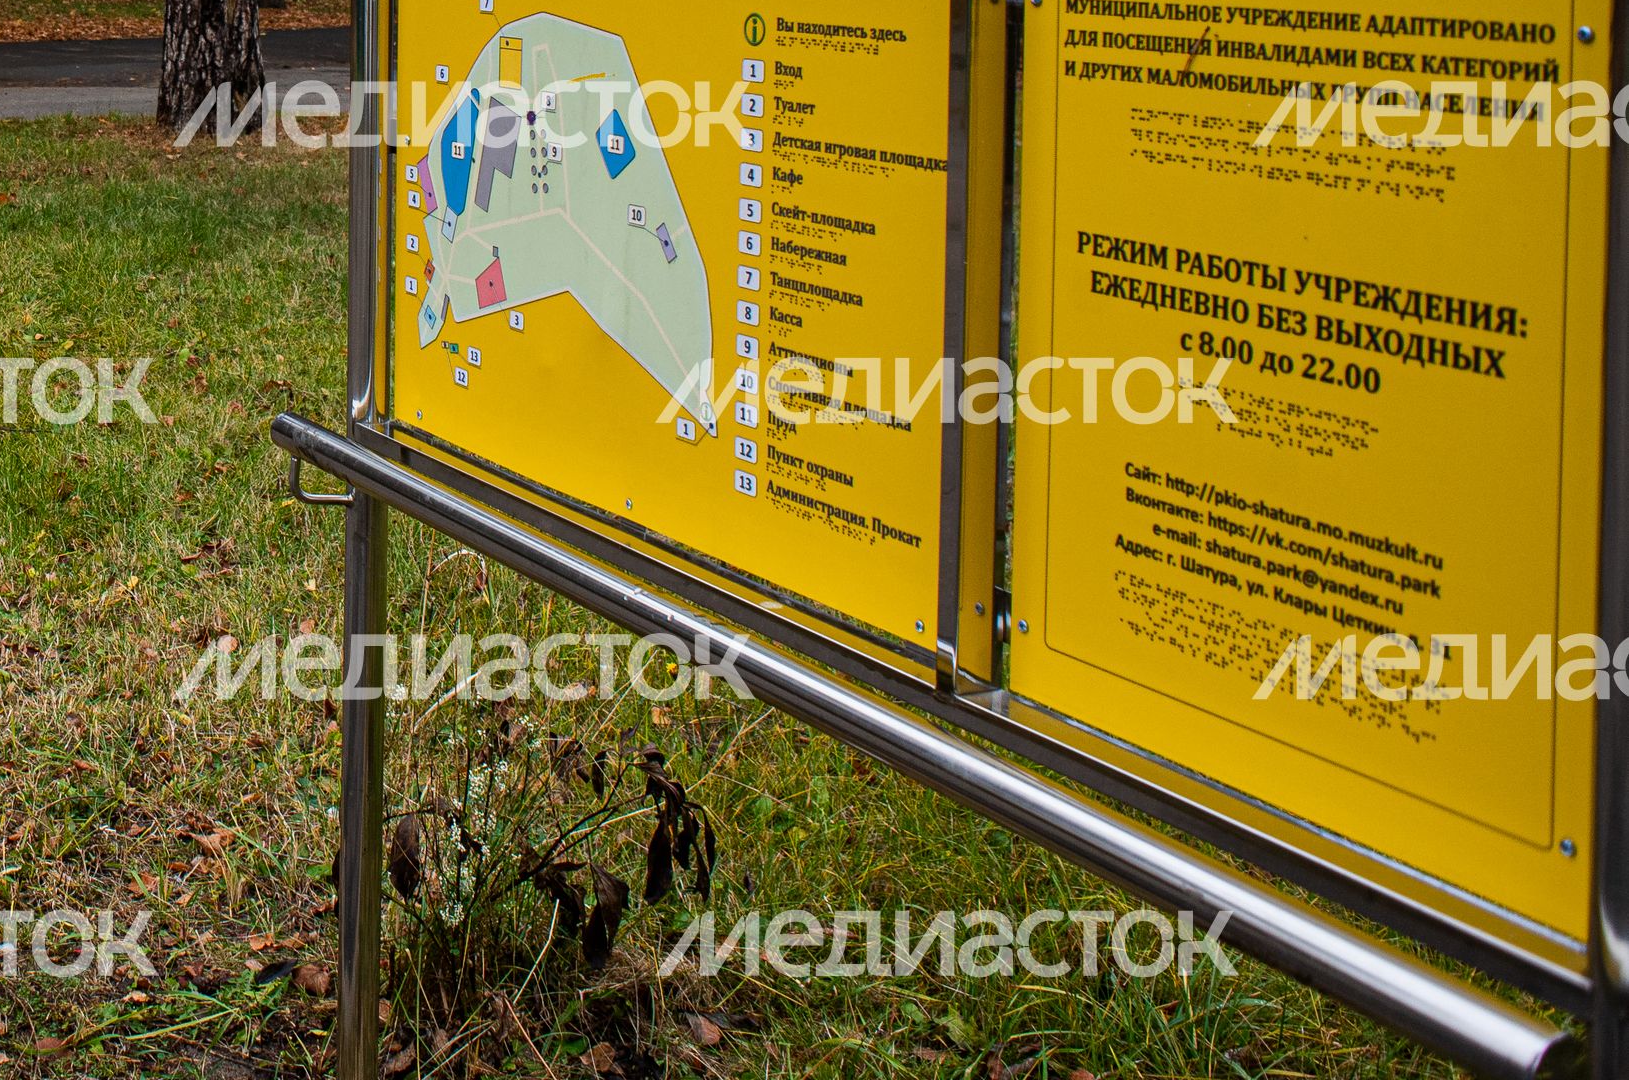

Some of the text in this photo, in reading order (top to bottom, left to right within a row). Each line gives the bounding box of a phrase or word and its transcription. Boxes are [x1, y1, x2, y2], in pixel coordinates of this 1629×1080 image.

[776, 17, 907, 43] Вы находитесь здесь
[1226, 7, 1361, 33] УЧРЕЖДЕНИЕ
[1365, 14, 1556, 44] АДАПТИРОВАНО
[1065, 29, 1559, 83] ДЛЯ ПОСЕЩЕНИЯ ИНВАЛИДАМИ ВСЕХ КАТЕГОРИЙ
[439, 68, 445, 79] 6
[749, 61, 802, 80] 1 Вход
[1065, 60, 1544, 122] И ДРУГИХ МАЛОМОБИЛЬНЫХ ГРУПП НАСЕЛЕНИЯ
[749, 96, 815, 119] 2 Туалет
[452, 145, 462, 157] 11
[551, 146, 557, 158] 9
[610, 138, 620, 151] 11
[748, 132, 947, 173] 3 Детская игровая площадка
[409, 168, 414, 180] 5
[747, 167, 803, 186] 4 Кафе
[411, 194, 417, 205] 4
[631, 209, 642, 222] 10
[747, 202, 876, 235] 5 Скейт-площадка
[410, 238, 415, 249] 2
[746, 236, 847, 266] 6 Набережная
[409, 280, 413, 291] 1
[745, 271, 863, 307] 7 Танцплощадка
[1076, 230, 1528, 339] РЕЖИМ РАБОТЫ УЧРЕЖДЕНИЯ:
[513, 314, 519, 326] 3
[745, 306, 802, 328] 8 Касса
[1090, 270, 1505, 379] ЕЖЕДНЕВНО БЕЗ ВЫХОДНЫХ
[470, 351, 478, 362] 13
[744, 340, 853, 378] 9 Аттракционы
[1180, 332, 1381, 395] с 8.00 до 22.00
[457, 371, 466, 383] 12
[740, 373, 912, 432] 10 Спортивная площадка
[682, 423, 689, 435] 1
[740, 407, 797, 435] 11 Пруд
[739, 442, 854, 487] 12 Пункт охраны
[739, 476, 922, 548] 13 Администрация. Прокат
[1125, 462, 1443, 570] Сайт: http://pkio-shatura.mo.muzkult.ru
[1126, 487, 1441, 599] Вконтакте: https://vk.com/shatura.park
[1115, 534, 1163, 563] Адрес:
[1167, 553, 1176, 567] г.
[1181, 555, 1242, 592] Шатура,
[1246, 578, 1269, 599] ул.
[1273, 586, 1328, 618] Клары
[1153, 523, 1403, 615] e-mail: shatura.park@yandex.ru
